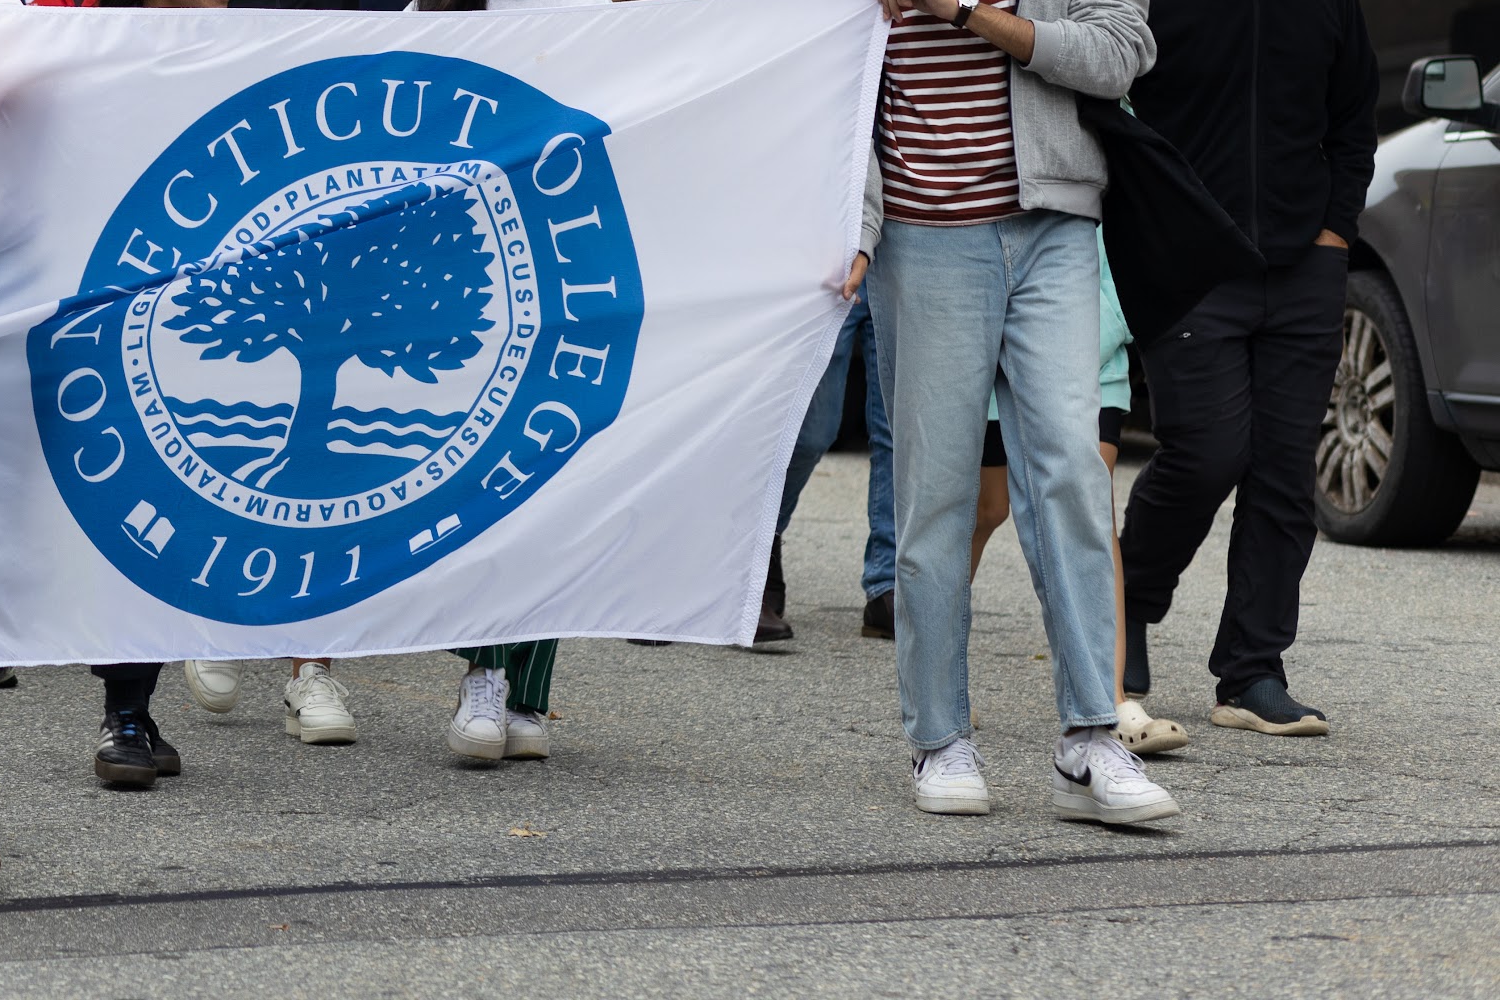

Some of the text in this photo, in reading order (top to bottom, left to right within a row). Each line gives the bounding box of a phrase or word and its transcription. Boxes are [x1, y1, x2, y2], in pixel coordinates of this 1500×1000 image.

[493, 196, 535, 305] SECUS
[131, 371, 229, 503] TANQUAM
[425, 322, 536, 482] DECURSUS
[244, 479, 408, 523] AQUARUM
[190, 535, 362, 599] 1911
